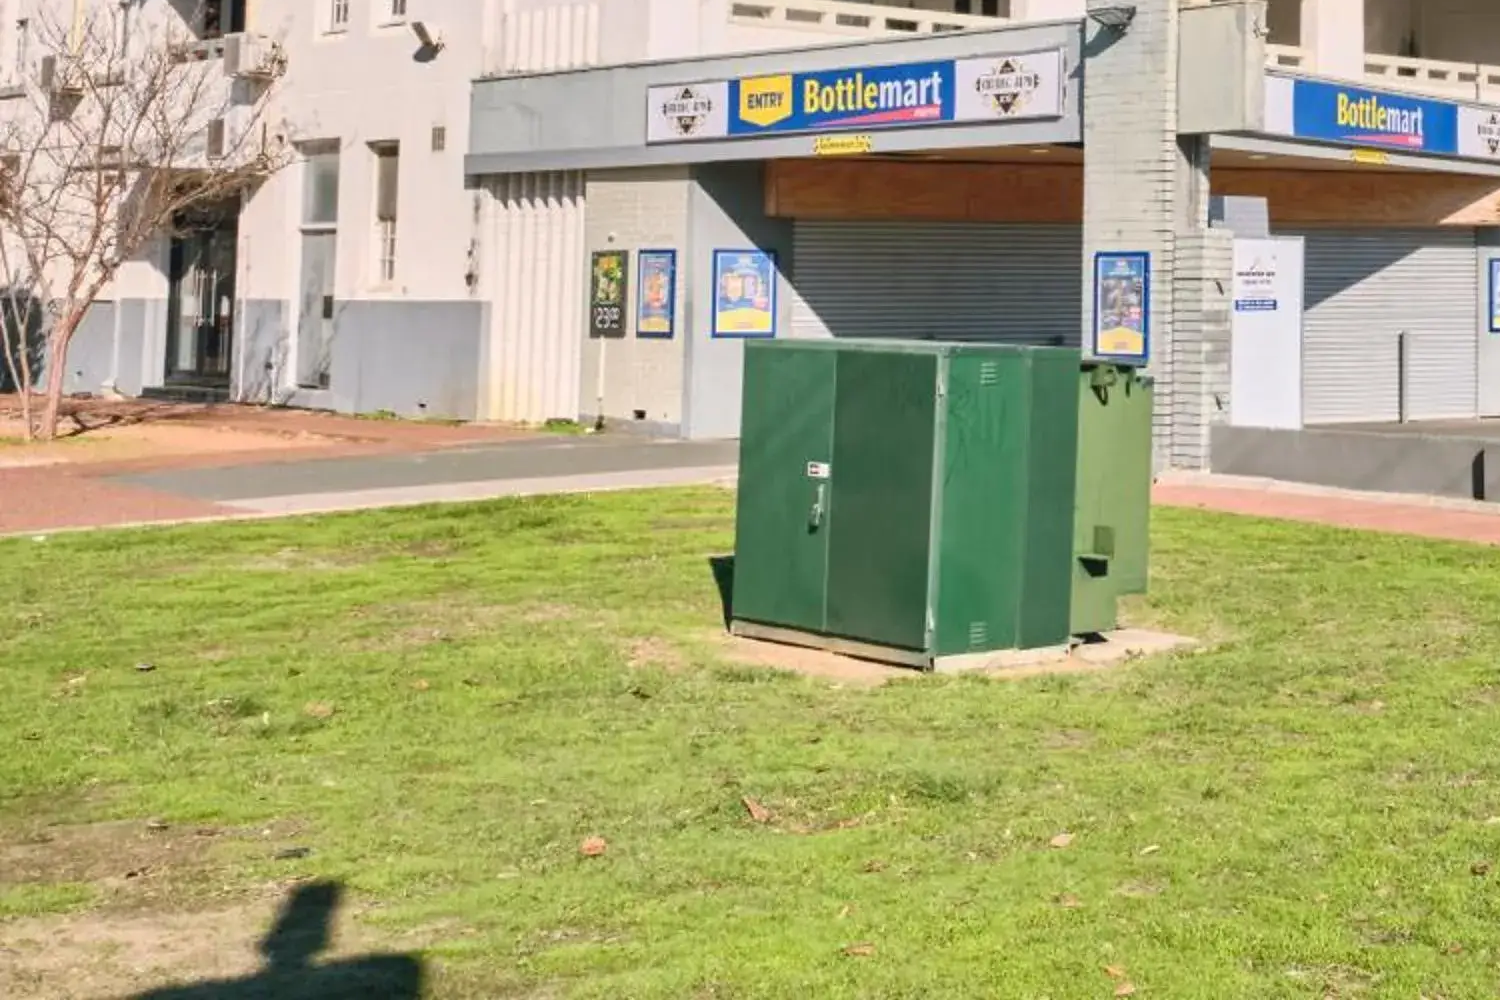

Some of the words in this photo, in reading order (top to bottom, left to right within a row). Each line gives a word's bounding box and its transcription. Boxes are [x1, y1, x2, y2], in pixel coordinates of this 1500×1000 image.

[747, 91, 784, 110] ENTRY
[804, 71, 943, 114] Bottlemart
[1337, 92, 1424, 136] Bottlemart
